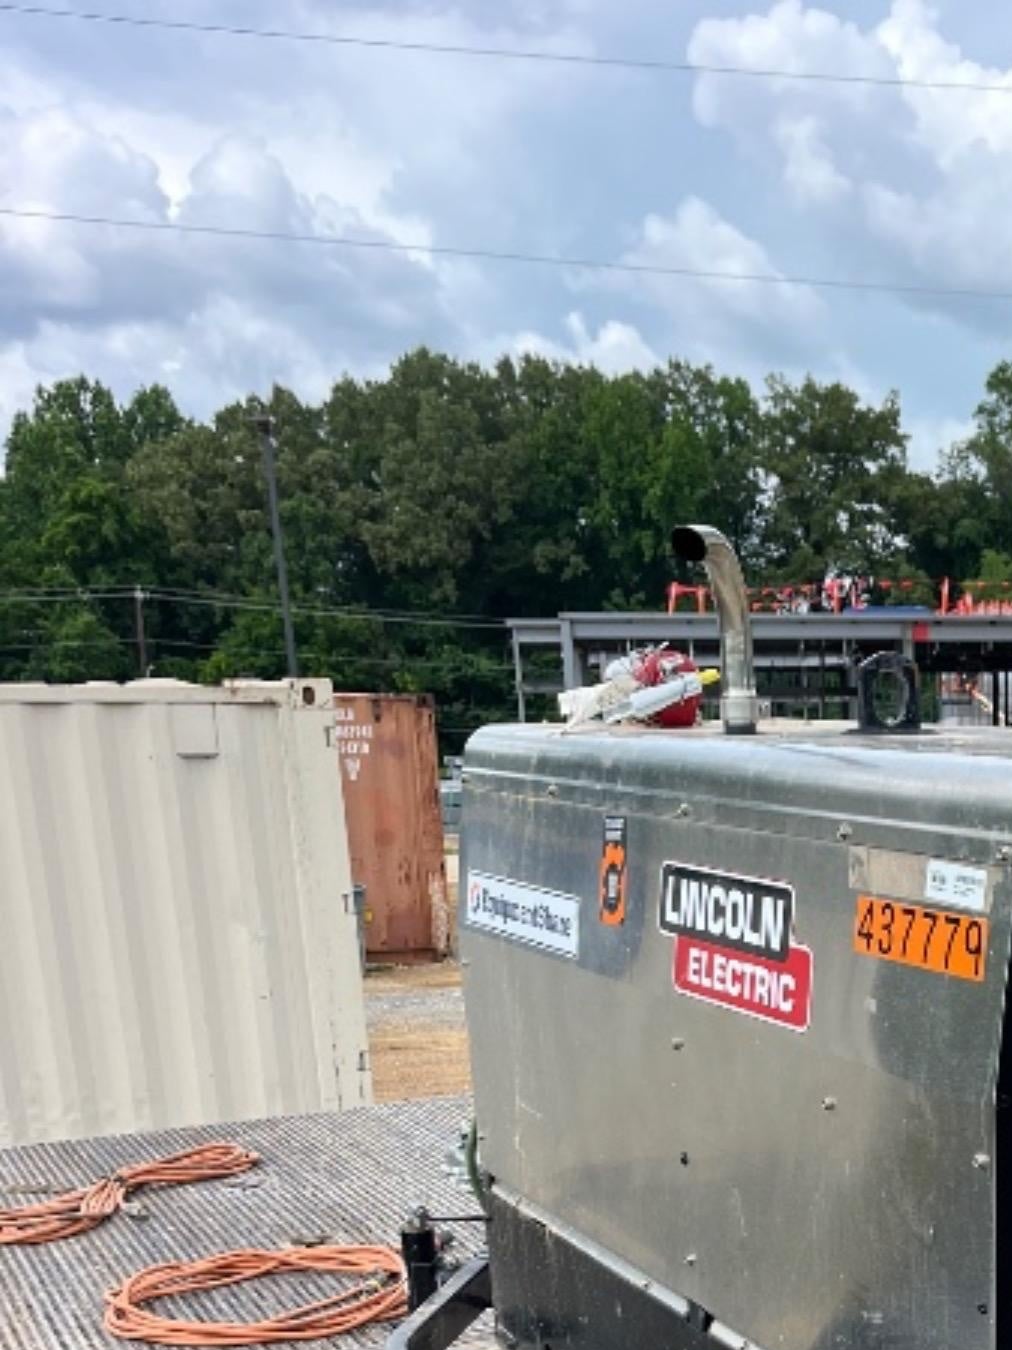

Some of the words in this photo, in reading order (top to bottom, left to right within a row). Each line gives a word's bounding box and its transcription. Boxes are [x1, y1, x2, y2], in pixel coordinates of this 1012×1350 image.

[665, 875, 785, 952] LINCOLN
[857, 900, 983, 977] 437779
[686, 946, 797, 1013] ELECTRIC
